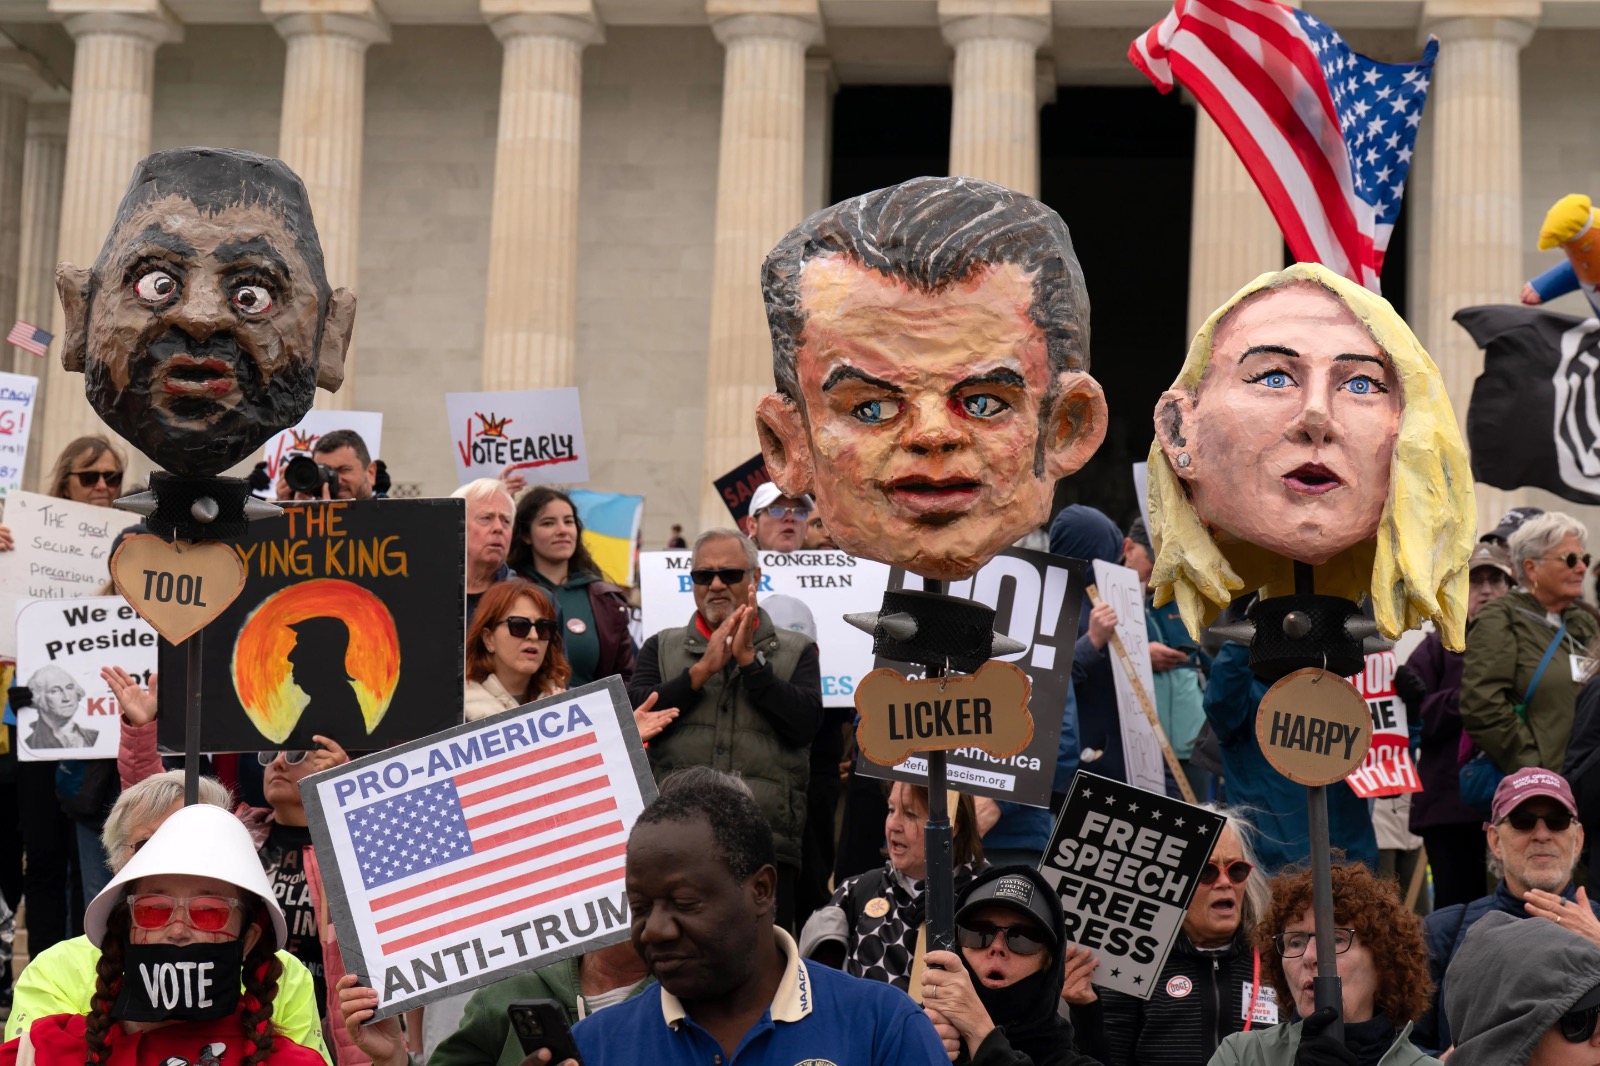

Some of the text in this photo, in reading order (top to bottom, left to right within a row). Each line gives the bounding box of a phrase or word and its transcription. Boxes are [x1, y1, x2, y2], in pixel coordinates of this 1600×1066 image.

[458, 417, 574, 468] VOTE EARLY
[37, 504, 109, 538] THE good
[280, 502, 348, 539] THE
[90, 545, 107, 559] for
[235, 535, 410, 578] YING KING
[763, 553, 857, 567] CONGRESS
[142, 568, 207, 608] TOOL
[796, 574, 852, 588] THAN
[63, 605, 107, 627] We
[45, 628, 158, 660] Preside
[821, 675, 854, 696] ES
[1345, 651, 1398, 696] TOP
[888, 697, 993, 741] LICKER
[1269, 710, 1361, 761] HARPY
[1369, 700, 1397, 730] HE
[333, 703, 594, 808] PRO-AMERICA
[1078, 809, 1189, 868] FREE
[1053, 838, 1190, 903] SPEECH
[1055, 875, 1161, 932] FREE
[382, 891, 631, 1004] ANTI-TRUM
[1064, 910, 1160, 965] RESS
[139, 961, 215, 1010] VOTE
